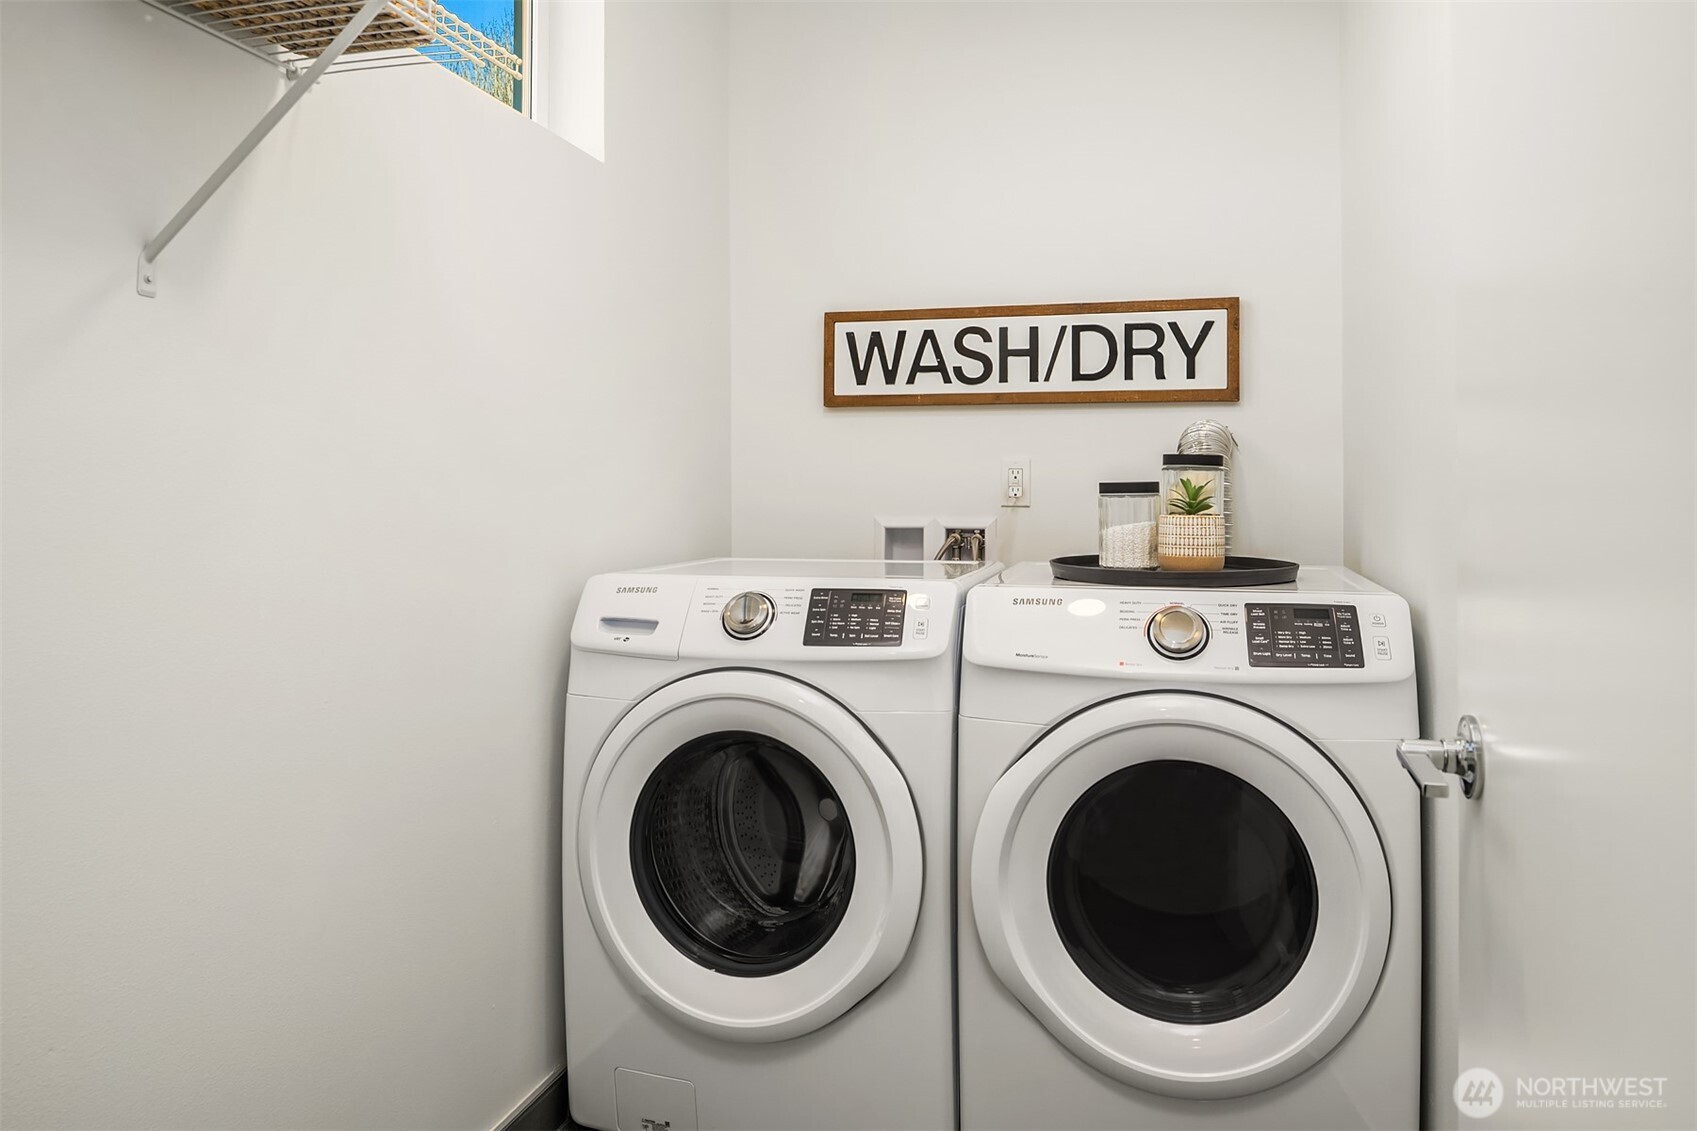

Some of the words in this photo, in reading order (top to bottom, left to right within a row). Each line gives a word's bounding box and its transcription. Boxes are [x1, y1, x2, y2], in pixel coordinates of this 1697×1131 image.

[846, 320, 1215, 386] WASH/DRY
[616, 586, 658, 594] SAMSUNG
[1012, 597, 1063, 606] SAMSUNG
